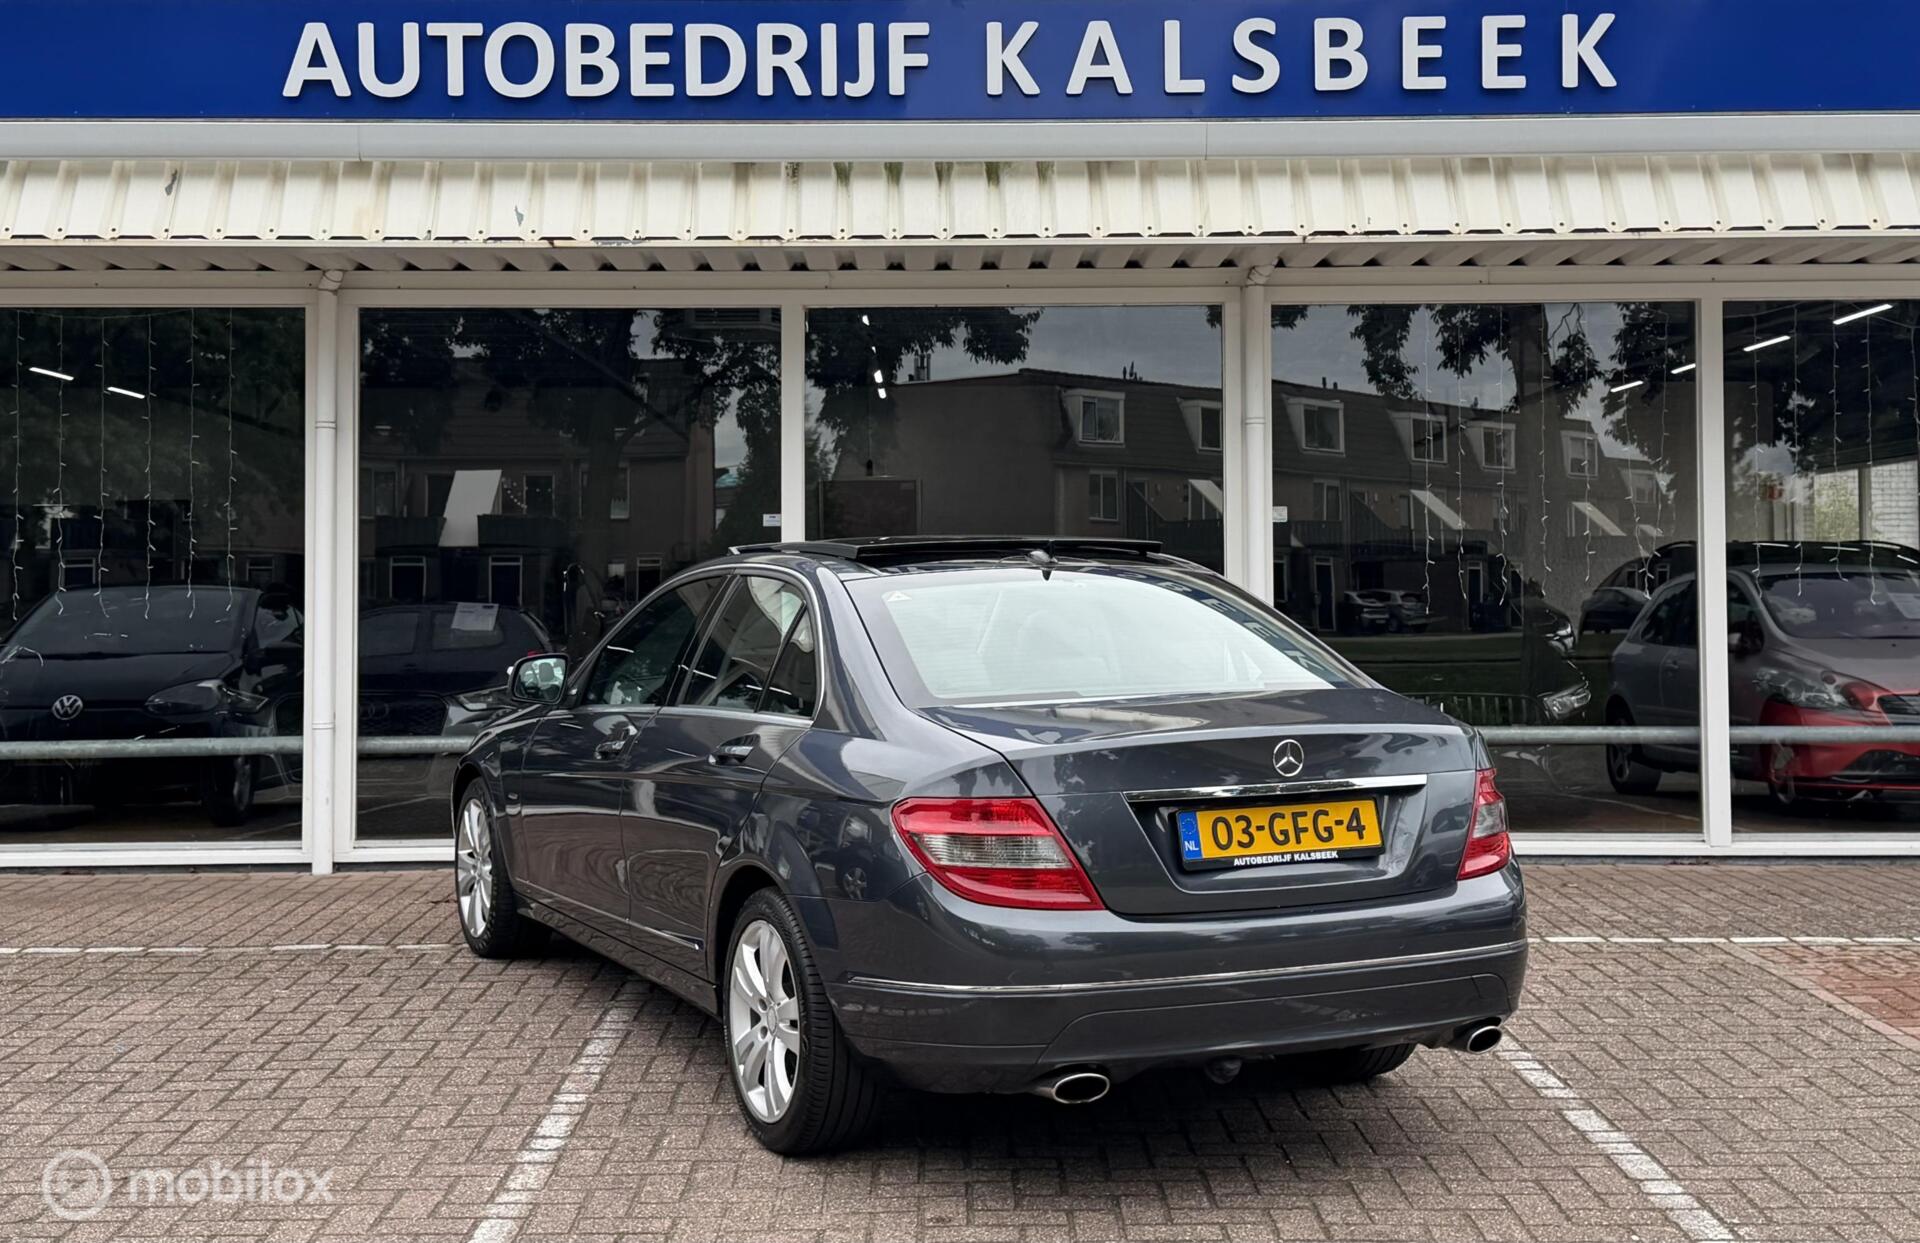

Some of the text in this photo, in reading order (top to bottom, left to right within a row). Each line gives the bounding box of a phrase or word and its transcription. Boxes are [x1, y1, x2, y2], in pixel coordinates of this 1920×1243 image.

[282, 13, 1617, 98] AUTOBEDRIJF KALSBEEK
[1211, 807, 1366, 850] 03-GFG-4
[1184, 840, 1200, 851] NL
[1233, 850, 1339, 866] AUTOBEDRIJF KALSBEEK
